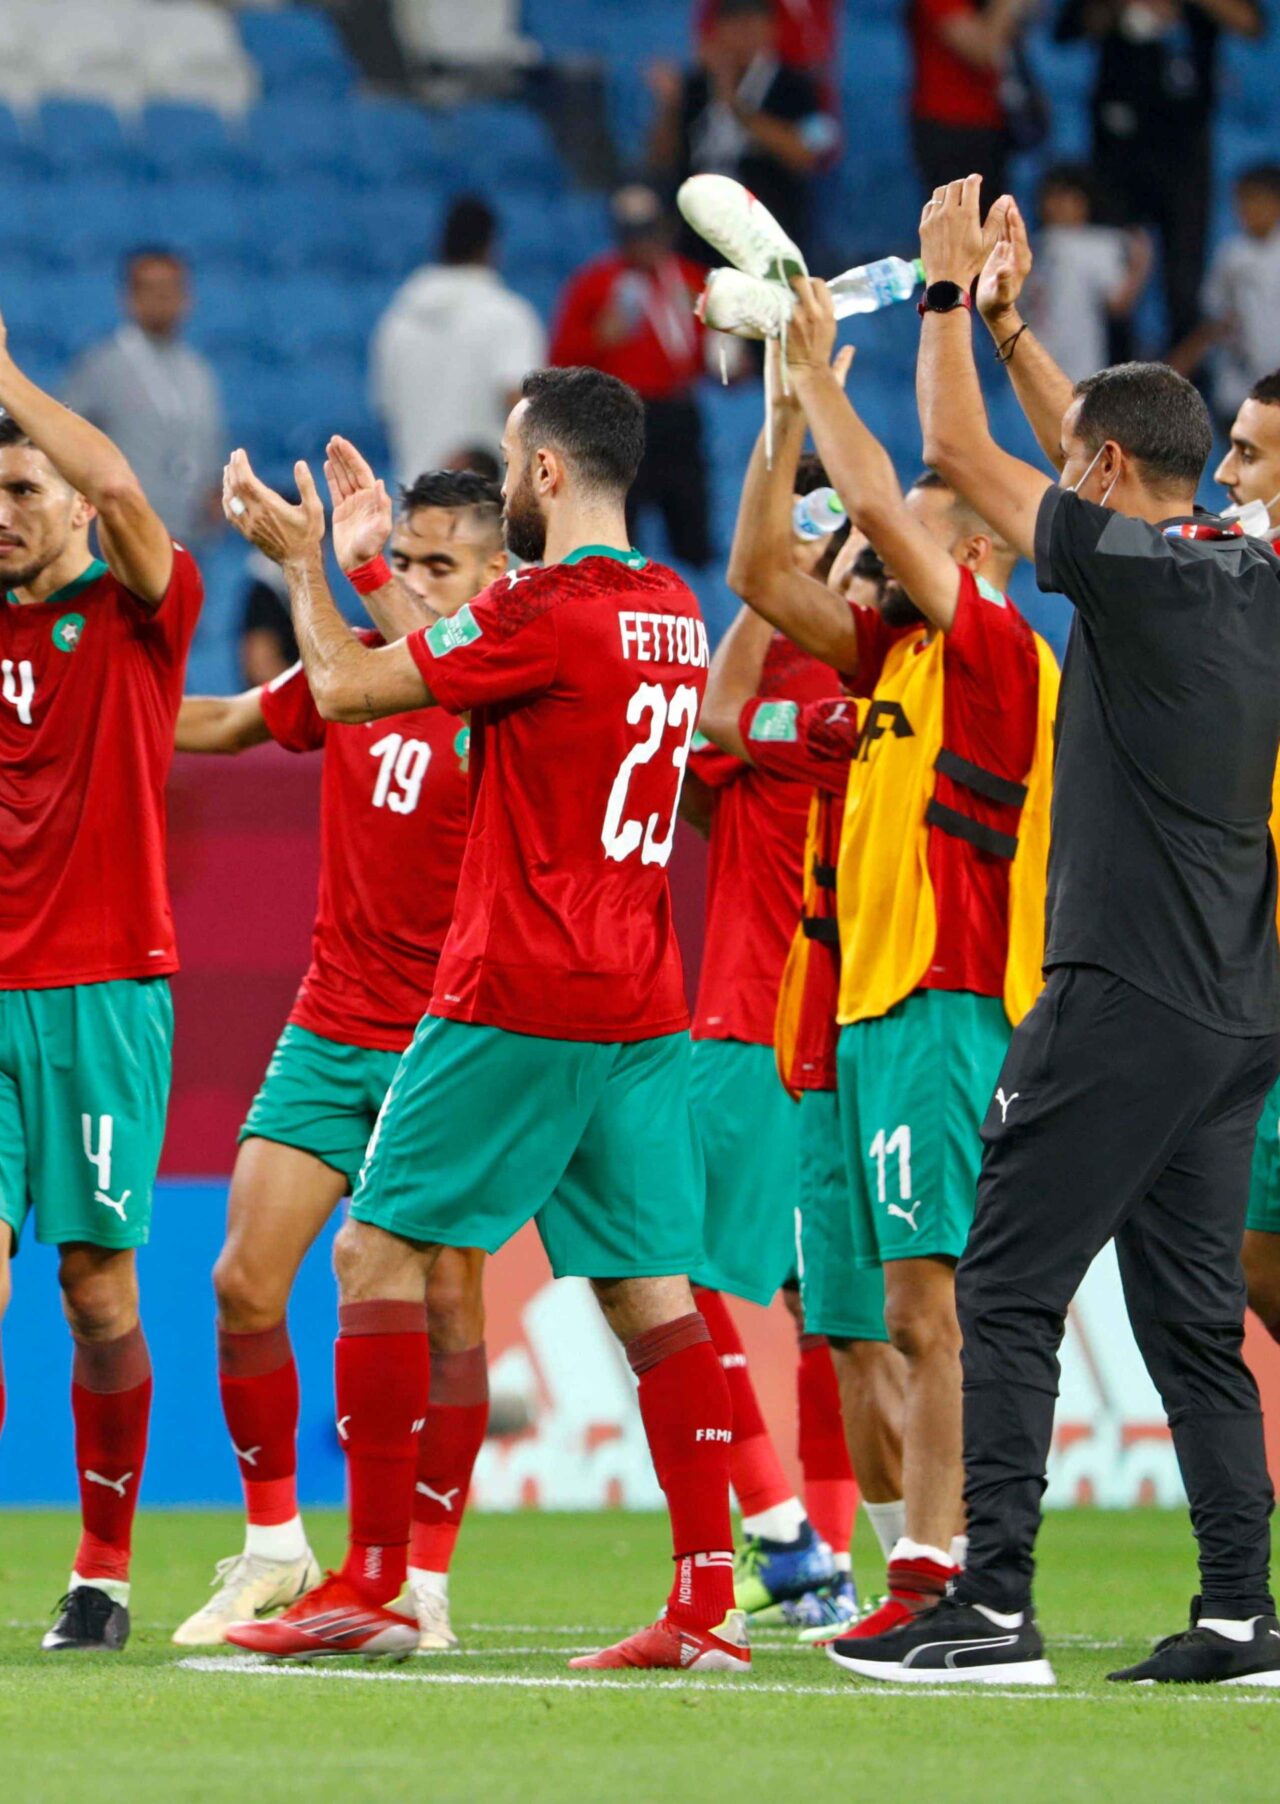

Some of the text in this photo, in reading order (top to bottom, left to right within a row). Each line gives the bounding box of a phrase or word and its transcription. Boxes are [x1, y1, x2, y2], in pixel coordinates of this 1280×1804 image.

[1, 659, 34, 725] 4
[369, 732, 432, 815] 19
[601, 682, 698, 868] 23
[82, 1113, 113, 1190] 4
[869, 1124, 912, 1203] 11
